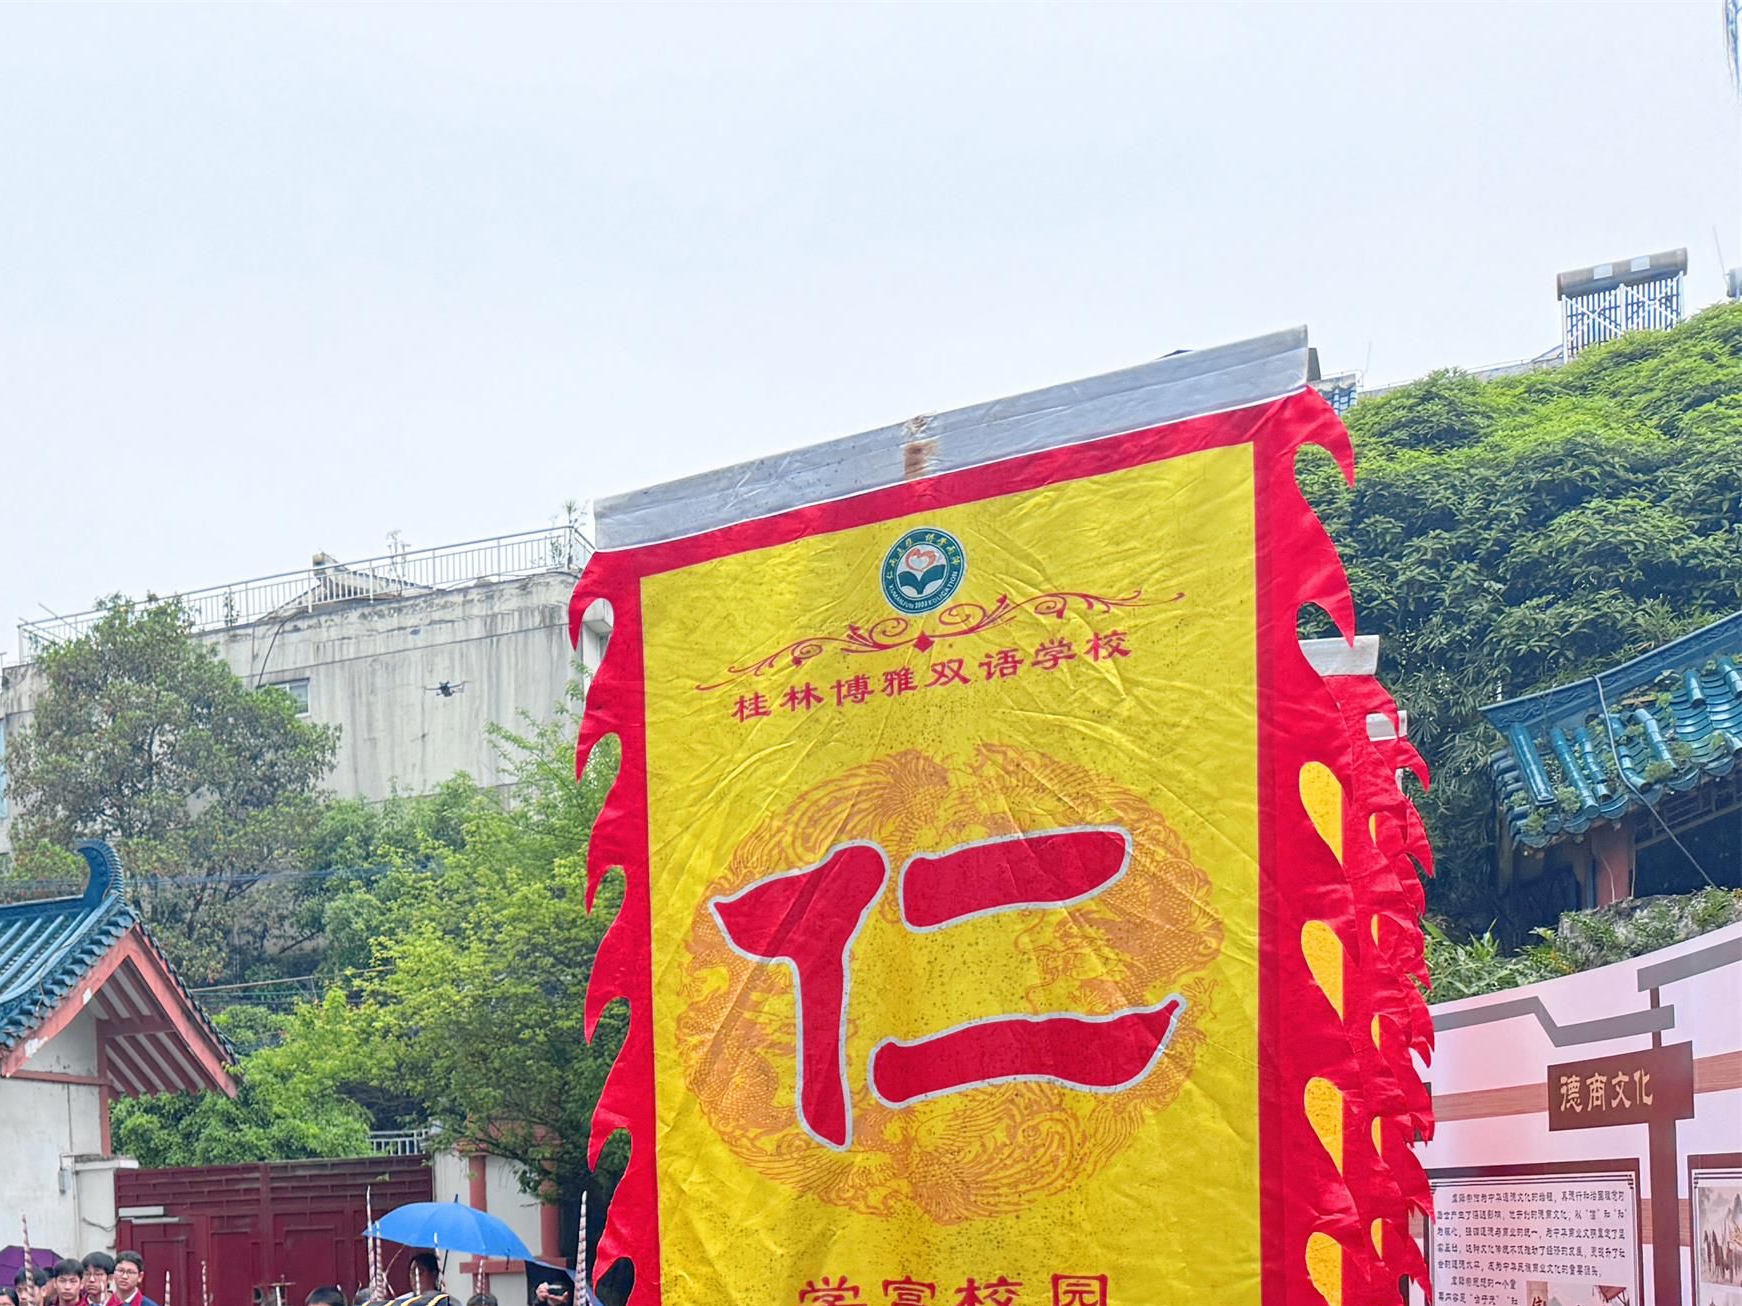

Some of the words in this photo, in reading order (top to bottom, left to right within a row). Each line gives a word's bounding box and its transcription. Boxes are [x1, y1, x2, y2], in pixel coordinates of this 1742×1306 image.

[731, 631, 1131, 722] 桂林博雅双语学校
[709, 825, 1186, 1151] 仁
[1560, 1068, 1654, 1113] 德商文化
